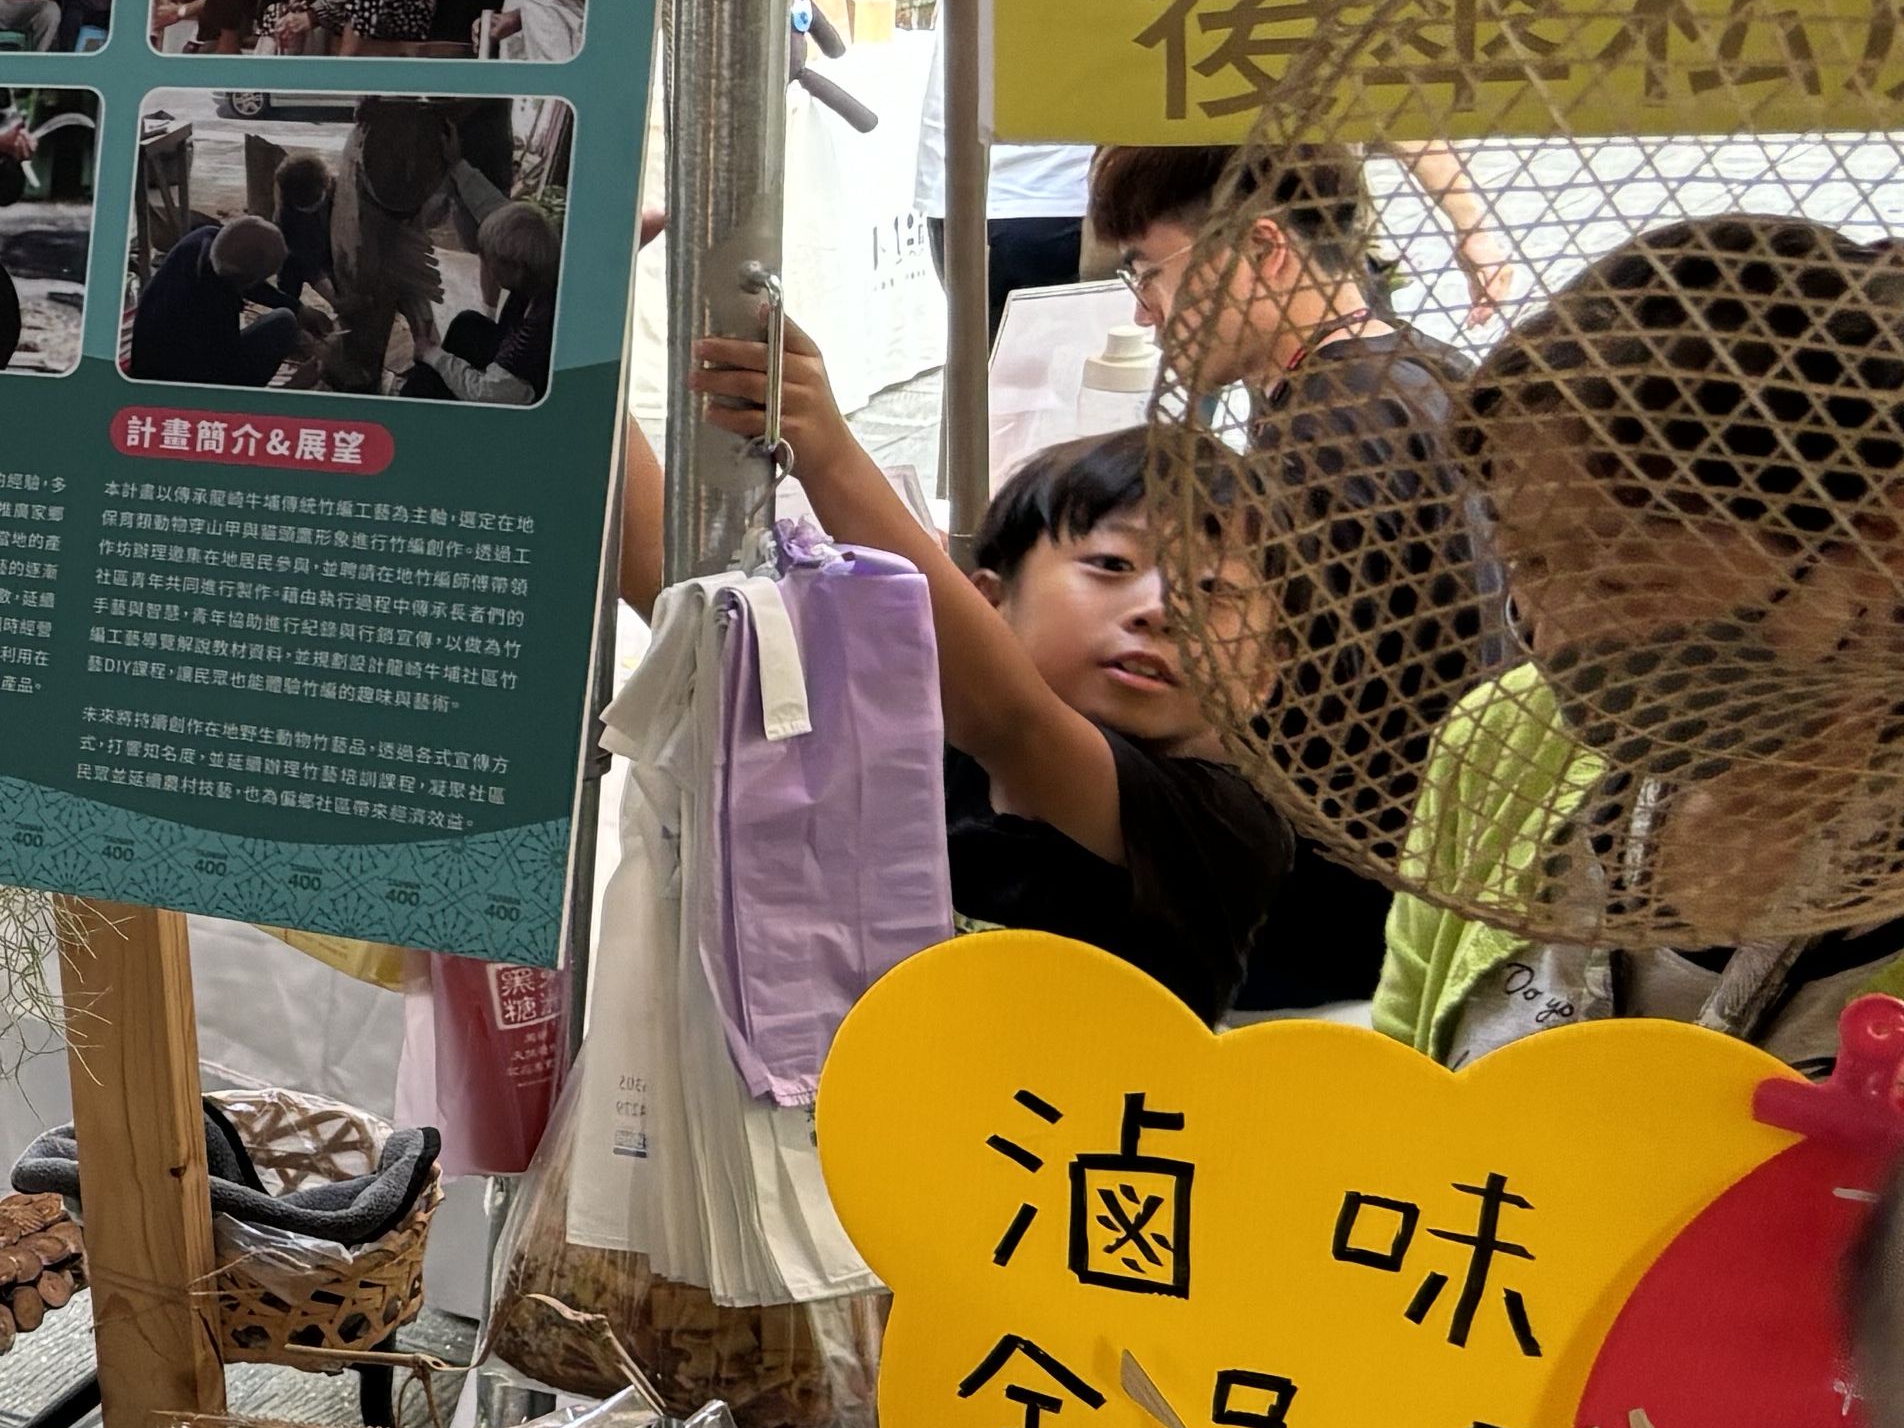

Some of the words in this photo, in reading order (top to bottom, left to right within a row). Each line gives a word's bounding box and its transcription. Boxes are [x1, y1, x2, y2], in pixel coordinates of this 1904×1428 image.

[125, 415, 367, 466] 計畫簡介&展望
[12, 830, 44, 848] 400
[102, 845, 134, 862] 400
[194, 859, 227, 877] 400
[288, 874, 322, 892] 400
[385, 889, 420, 907] 400
[485, 904, 520, 922] 400
[984, 1088, 1544, 1360] 滷味
